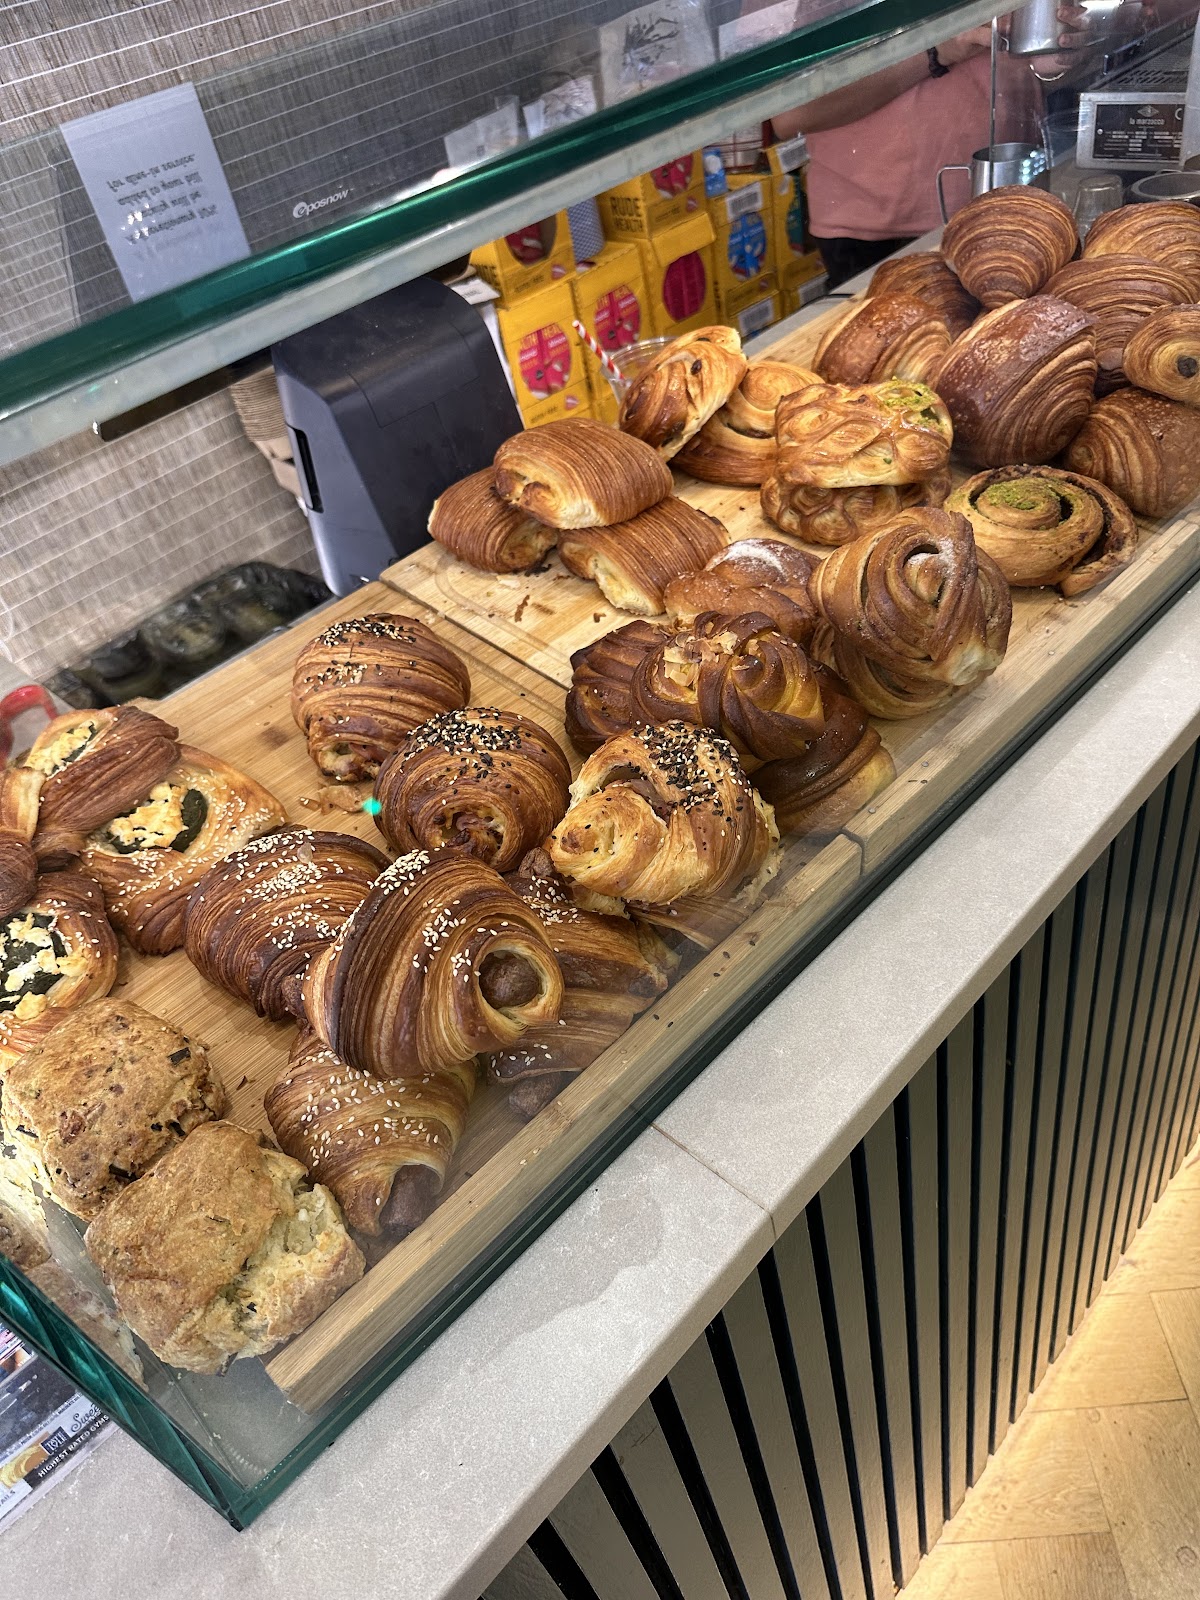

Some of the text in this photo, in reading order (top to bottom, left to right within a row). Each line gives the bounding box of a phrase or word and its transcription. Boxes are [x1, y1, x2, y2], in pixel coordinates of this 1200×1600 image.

[610, 196, 642, 217] RUDE
[614, 217, 646, 233] HEALTH
[70, 1402, 102, 1433] Swee
[38, 1449, 69, 1478] HIGHEST
[68, 1431, 91, 1452] RATED
[89, 1413, 110, 1432] GYMS
